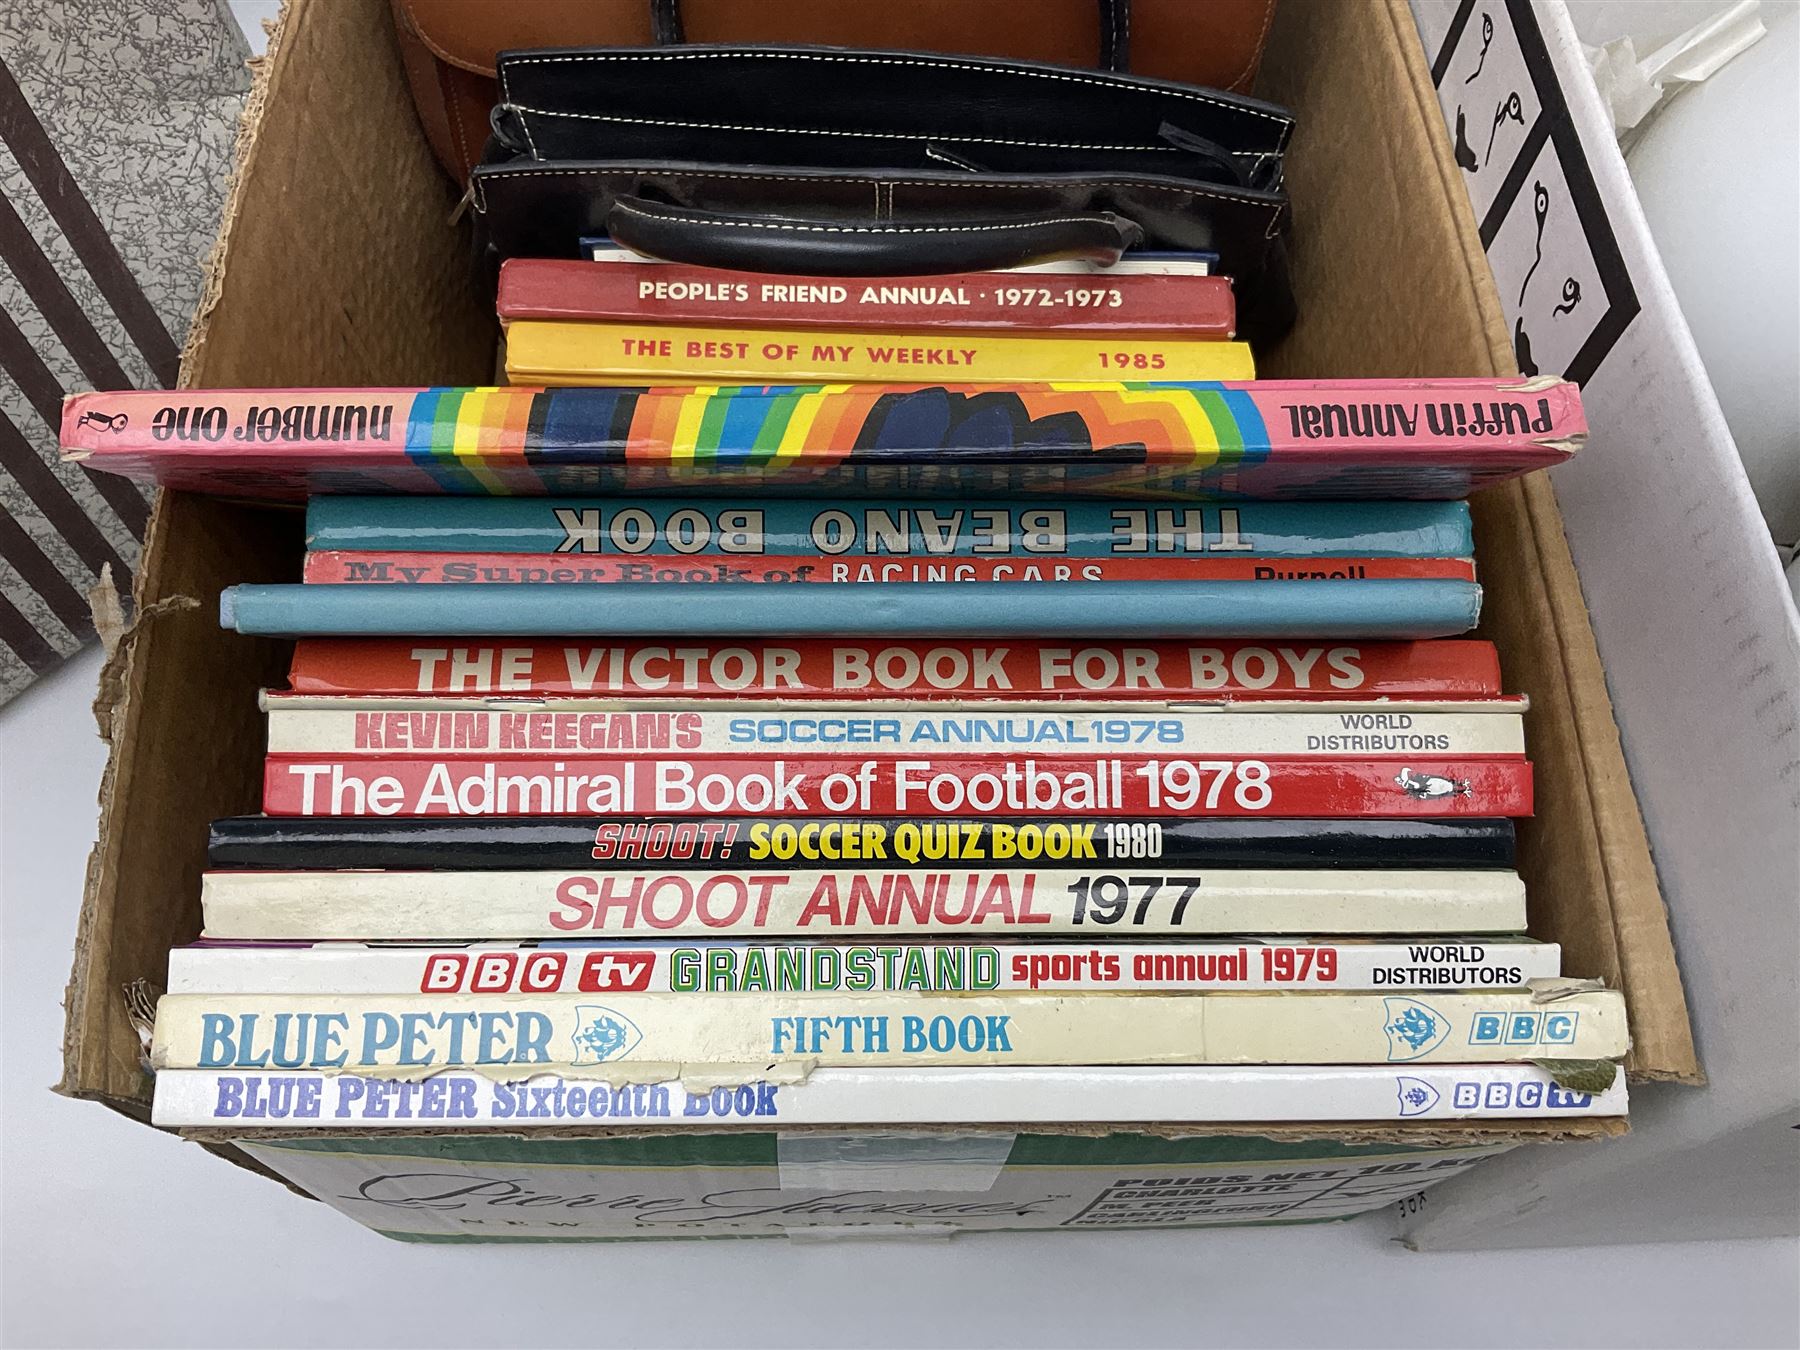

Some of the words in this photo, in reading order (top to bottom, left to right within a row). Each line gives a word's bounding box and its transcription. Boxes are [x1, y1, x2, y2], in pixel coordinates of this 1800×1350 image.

[638, 281, 750, 304] PEOPLE'S
[761, 283, 848, 306] FRIEND
[859, 285, 971, 308] ANNUAL
[994, 287, 1124, 309] 1972-1973
[621, 339, 674, 359] THE
[685, 341, 751, 361] BEST
[761, 342, 799, 363] OF
[811, 344, 856, 364] MY
[866, 345, 978, 367] WEEKLY
[1098, 353, 1166, 371] 1985
[151, 407, 226, 440] one
[555, 508, 765, 555] BOOK
[811, 508, 1068, 555] BEANO
[1110, 508, 1255, 554] THE
[344, 561, 431, 583] My
[441, 562, 606, 583] Super
[616, 563, 754, 583] Book
[763, 565, 815, 583] of
[831, 563, 978, 582] RACING
[410, 648, 534, 692] THE
[565, 648, 803, 692] VICTOR
[832, 647, 1011, 692] BOOK
[1038, 647, 1162, 691] FOR
[1190, 647, 1366, 691] BOYS
[355, 711, 490, 750] KEVIN
[498, 712, 703, 750] KEEGAN'S
[728, 718, 905, 744] SOCCER
[909, 719, 1090, 744] ANNUAL
[1089, 720, 1185, 744] 1978
[1340, 714, 1414, 730] WORLD
[1306, 733, 1450, 752] DISTRIBUTORS
[288, 764, 405, 816] The
[414, 762, 632, 816] Admiral
[655, 761, 809, 814] Book
[820, 761, 881, 813] of
[895, 758, 1122, 812] Football
[1136, 760, 1274, 810] 1978
[591, 823, 739, 862] SHOOT!
[749, 822, 886, 861] SOCCER
[893, 823, 984, 862] QUIZ
[991, 823, 1099, 860] BOOK
[1105, 823, 1164, 859] 1980
[549, 875, 791, 931] SHOOT
[797, 874, 1053, 926] ANNUAL
[1064, 875, 1202, 926] 1977
[420, 953, 568, 994] BBC
[577, 951, 657, 993] tv
[669, 946, 1001, 992] GRANDSTAND
[1011, 953, 1120, 989] sports
[1133, 950, 1248, 983] annual
[1261, 950, 1339, 983] 1979
[1408, 946, 1486, 964] WORLD
[1372, 967, 1523, 987] DISTRIBUTORS
[197, 1012, 349, 1068] BLUE
[360, 1011, 556, 1066] PETER
[771, 1016, 887, 1055] FIFTH
[903, 1014, 1013, 1053] BOOK
[1469, 1012, 1579, 1045] BBC
[214, 1077, 322, 1119] BLUE
[334, 1078, 479, 1119] PETER
[491, 1079, 672, 1118] Sixteenth
[683, 1080, 779, 1117] Book
[1453, 1082, 1545, 1109] BBC
[1262, 1169, 1350, 1181] NET
